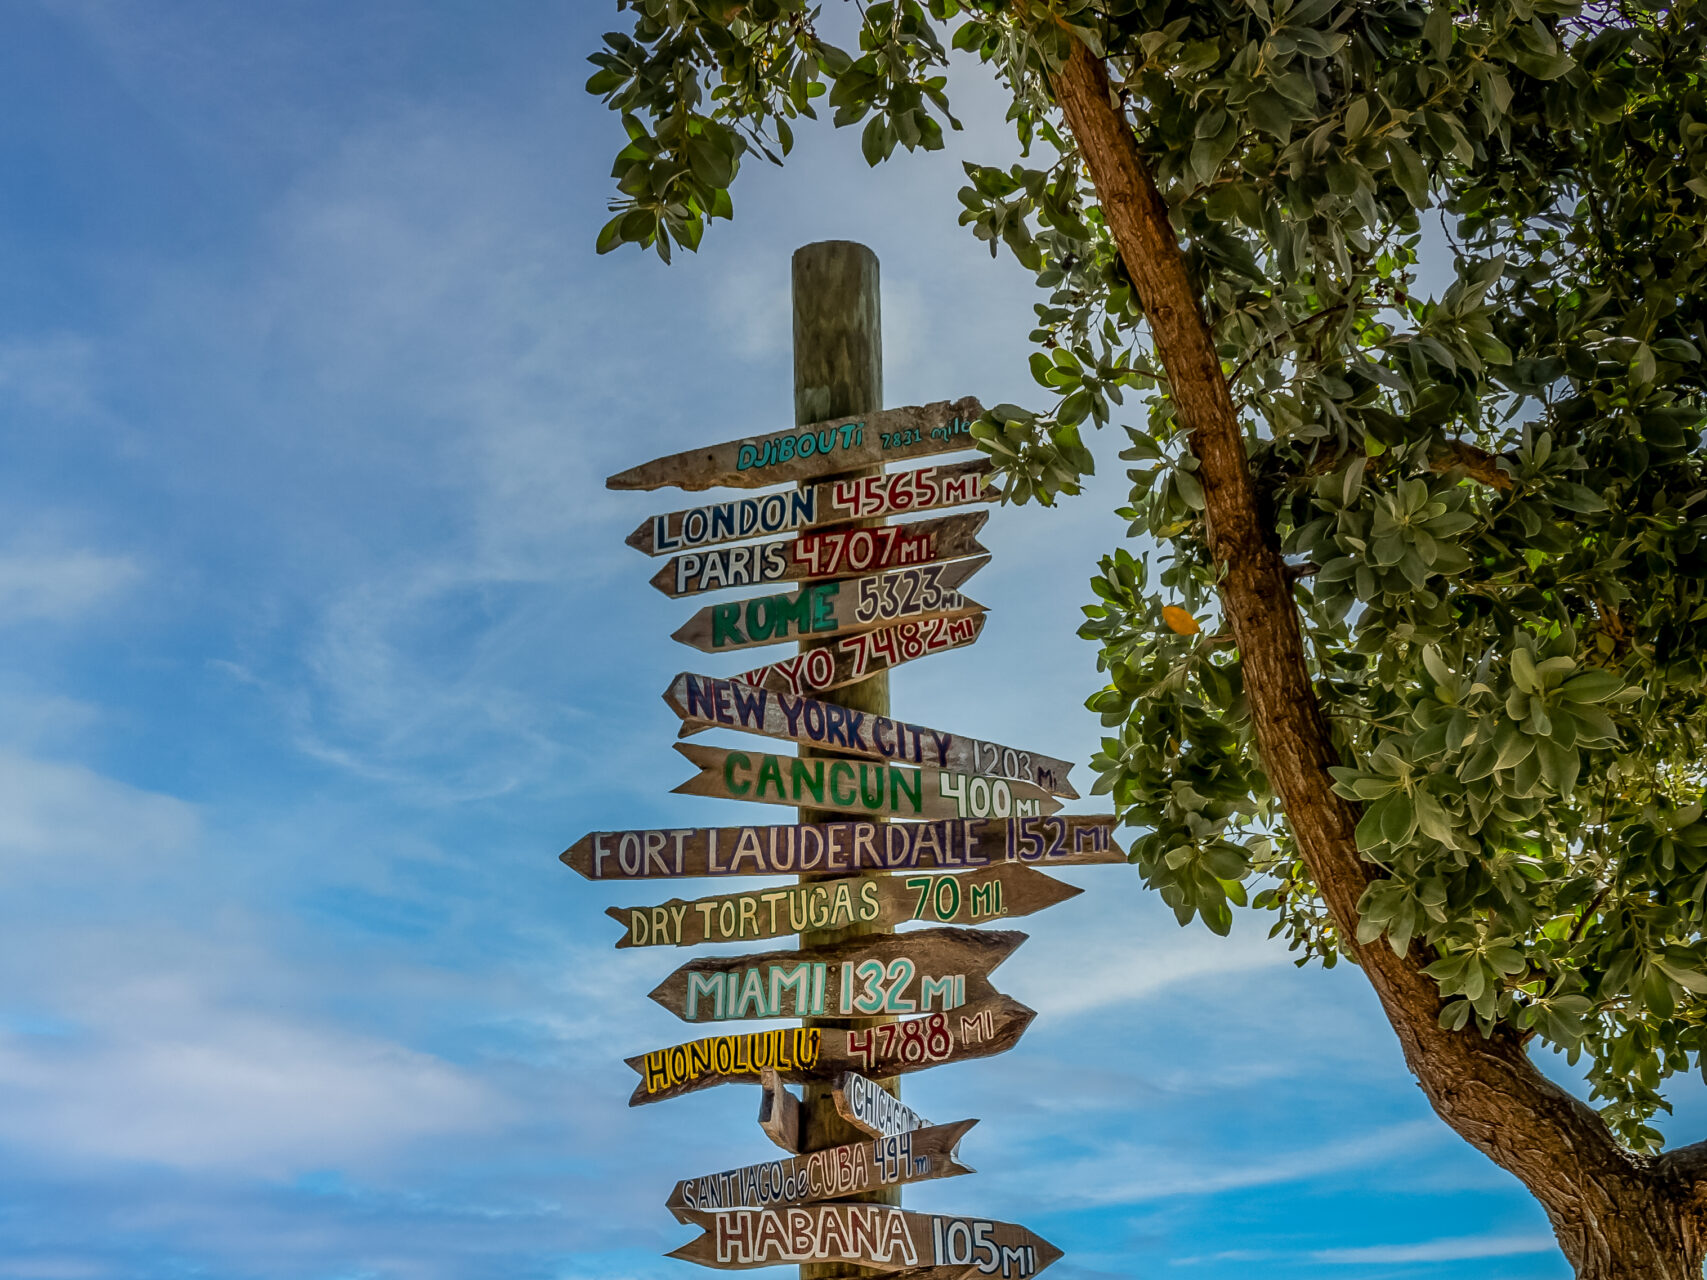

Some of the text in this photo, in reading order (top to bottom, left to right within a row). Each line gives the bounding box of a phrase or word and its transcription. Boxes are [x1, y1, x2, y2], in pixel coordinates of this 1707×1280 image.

[736, 417, 973, 471] DJiBOUTi 7831 mile
[654, 486, 818, 554] LONDON
[833, 467, 940, 518] 4565
[675, 540, 787, 594] PARIS
[711, 563, 964, 648] ROME 5323 MI
[840, 617, 948, 677] 7482
[948, 618, 974, 643] MI
[686, 673, 767, 730] NEW
[777, 691, 866, 749] YORK
[870, 716, 952, 768] CITY
[972, 740, 1034, 782] 1203
[723, 751, 1041, 820] CANCUN 400 MI
[591, 815, 1110, 878] FORT LAUDERDALE 152 MI
[630, 904, 688, 946] DRY
[695, 880, 881, 940] TORTUGAS
[905, 876, 961, 922] 70
[686, 957, 966, 1020] MIAMI 132 MI
[644, 1010, 995, 1093] HONOLULU 4788 MI
[851, 1072, 910, 1135] CHICAGO
[806, 1141, 869, 1197] CUBA
[873, 1132, 913, 1185] 494
[716, 1206, 1036, 1279] HABANA 105 MI
